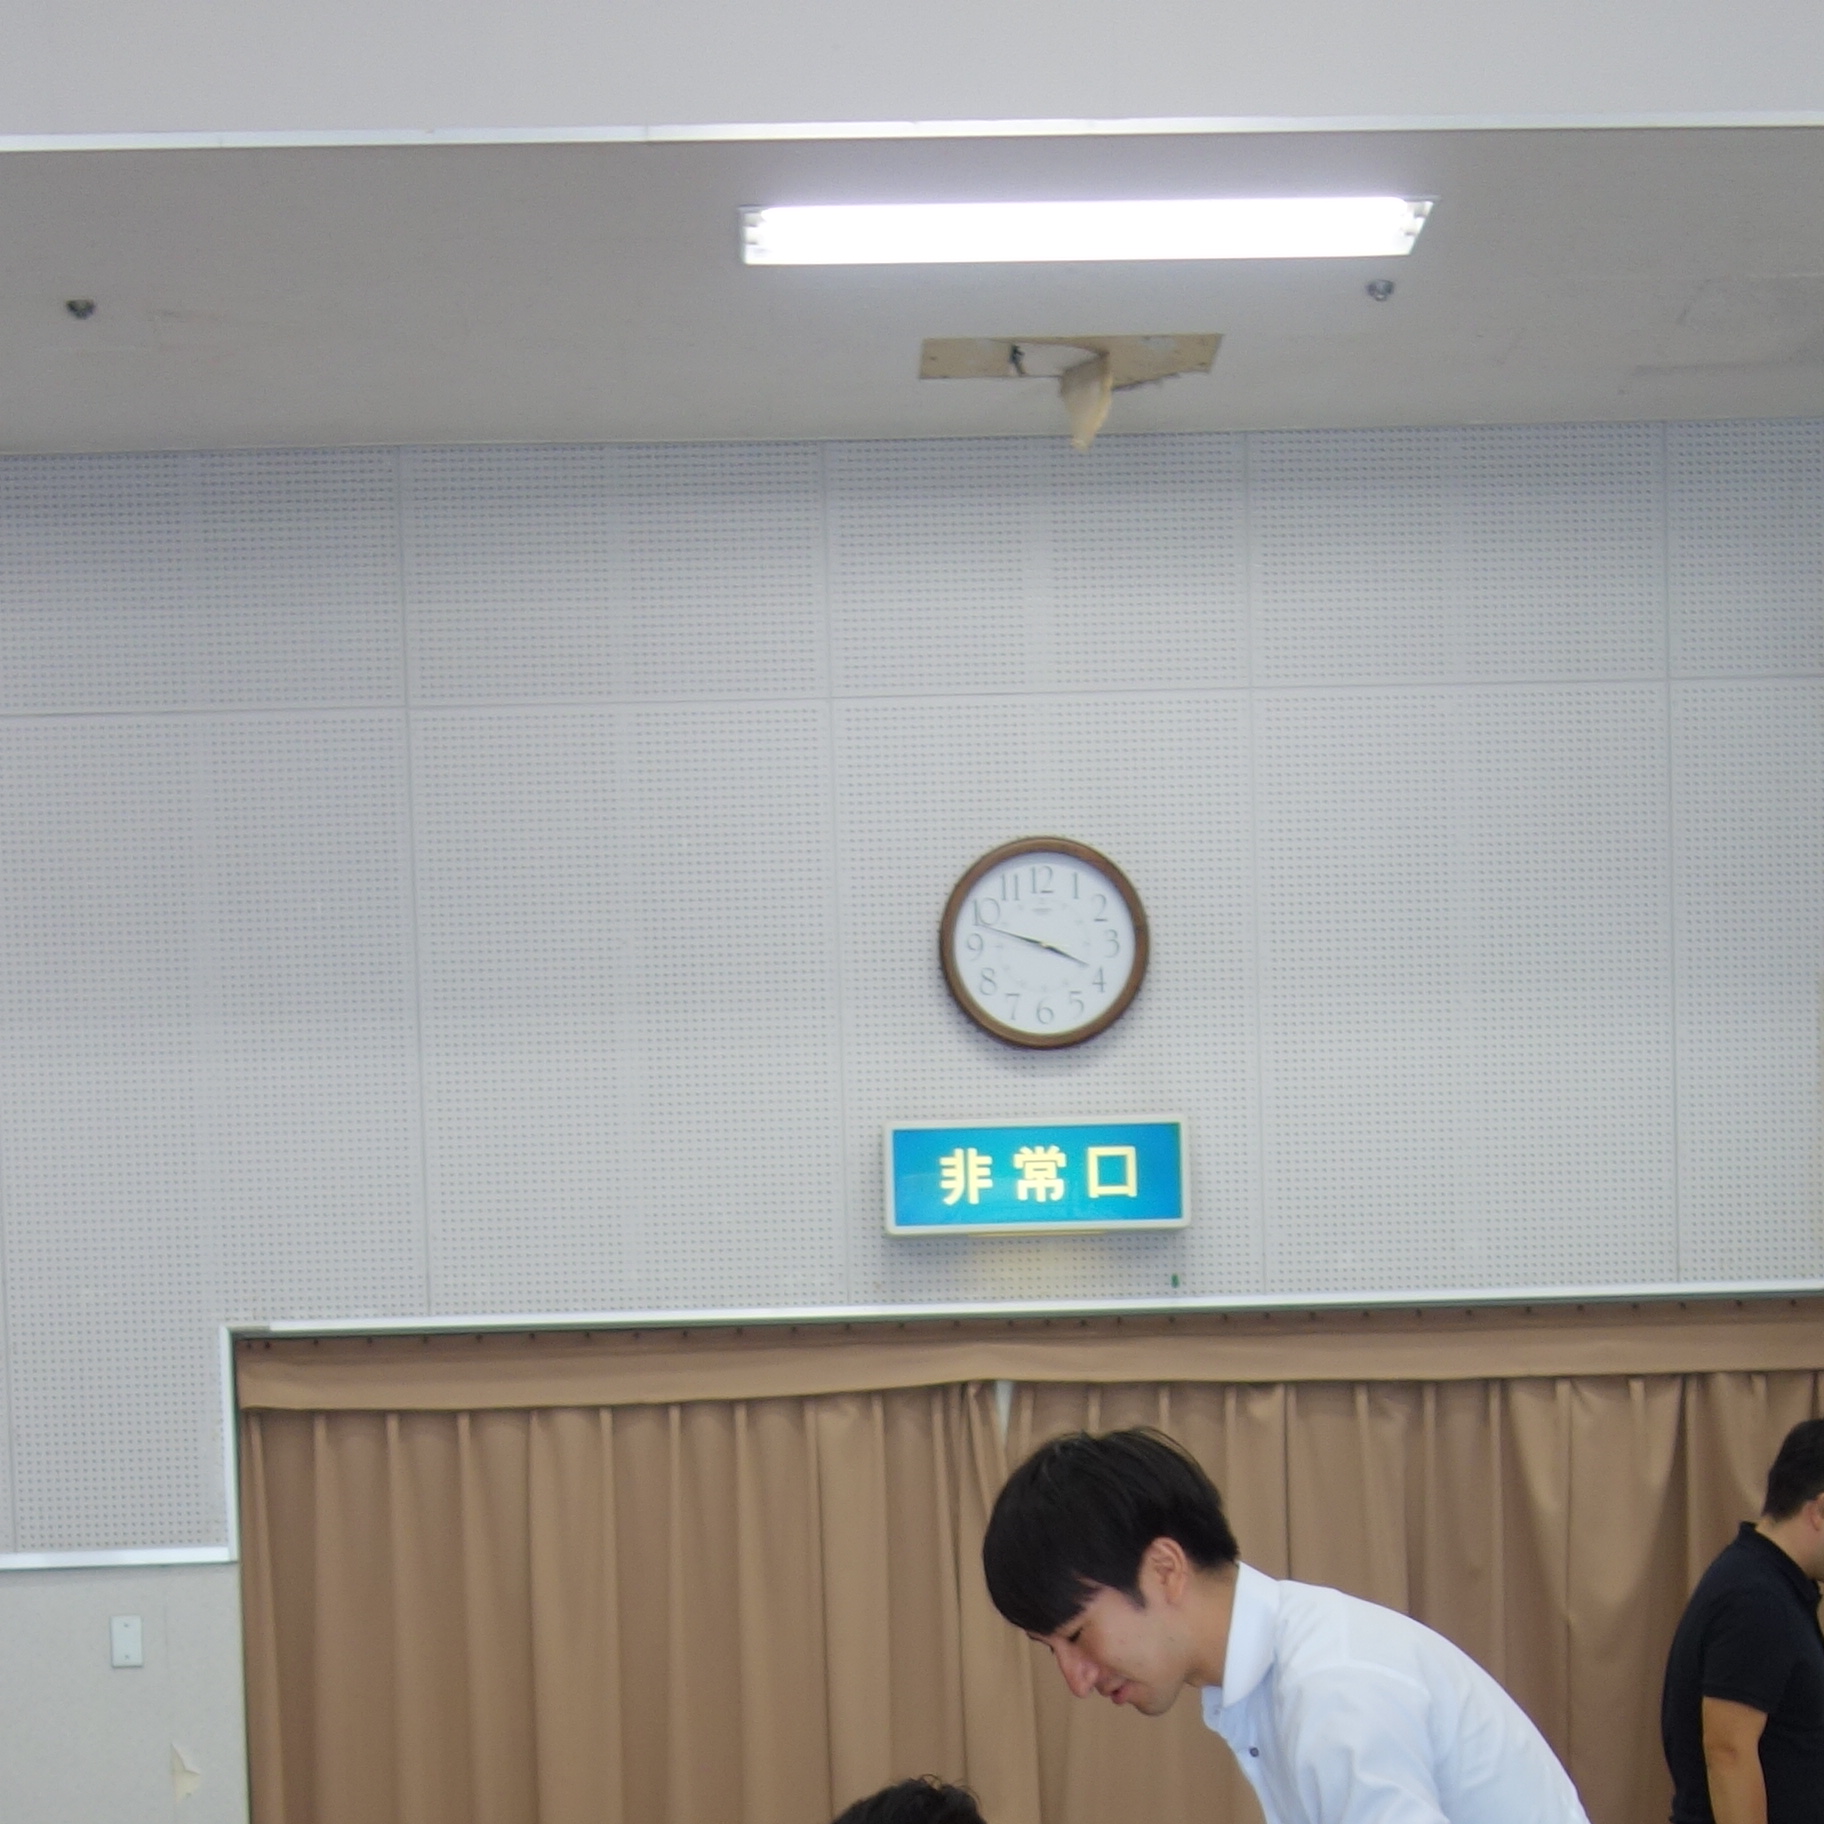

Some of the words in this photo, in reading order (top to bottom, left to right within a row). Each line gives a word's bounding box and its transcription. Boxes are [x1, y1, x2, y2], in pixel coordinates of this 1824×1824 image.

[1000, 873, 1021, 901] 11
[1030, 865, 1054, 894] 12
[973, 897, 1001, 927] 10
[1092, 893, 1108, 922] 2
[966, 932, 984, 961] 9
[1104, 929, 1120, 958] 3
[979, 967, 997, 996] 8
[1091, 966, 1107, 993] 4
[1005, 992, 1021, 1021] 7
[1035, 997, 1055, 1025] 6
[1069, 990, 1085, 1019] 5
[939, 1145, 1138, 1206] 非常口
